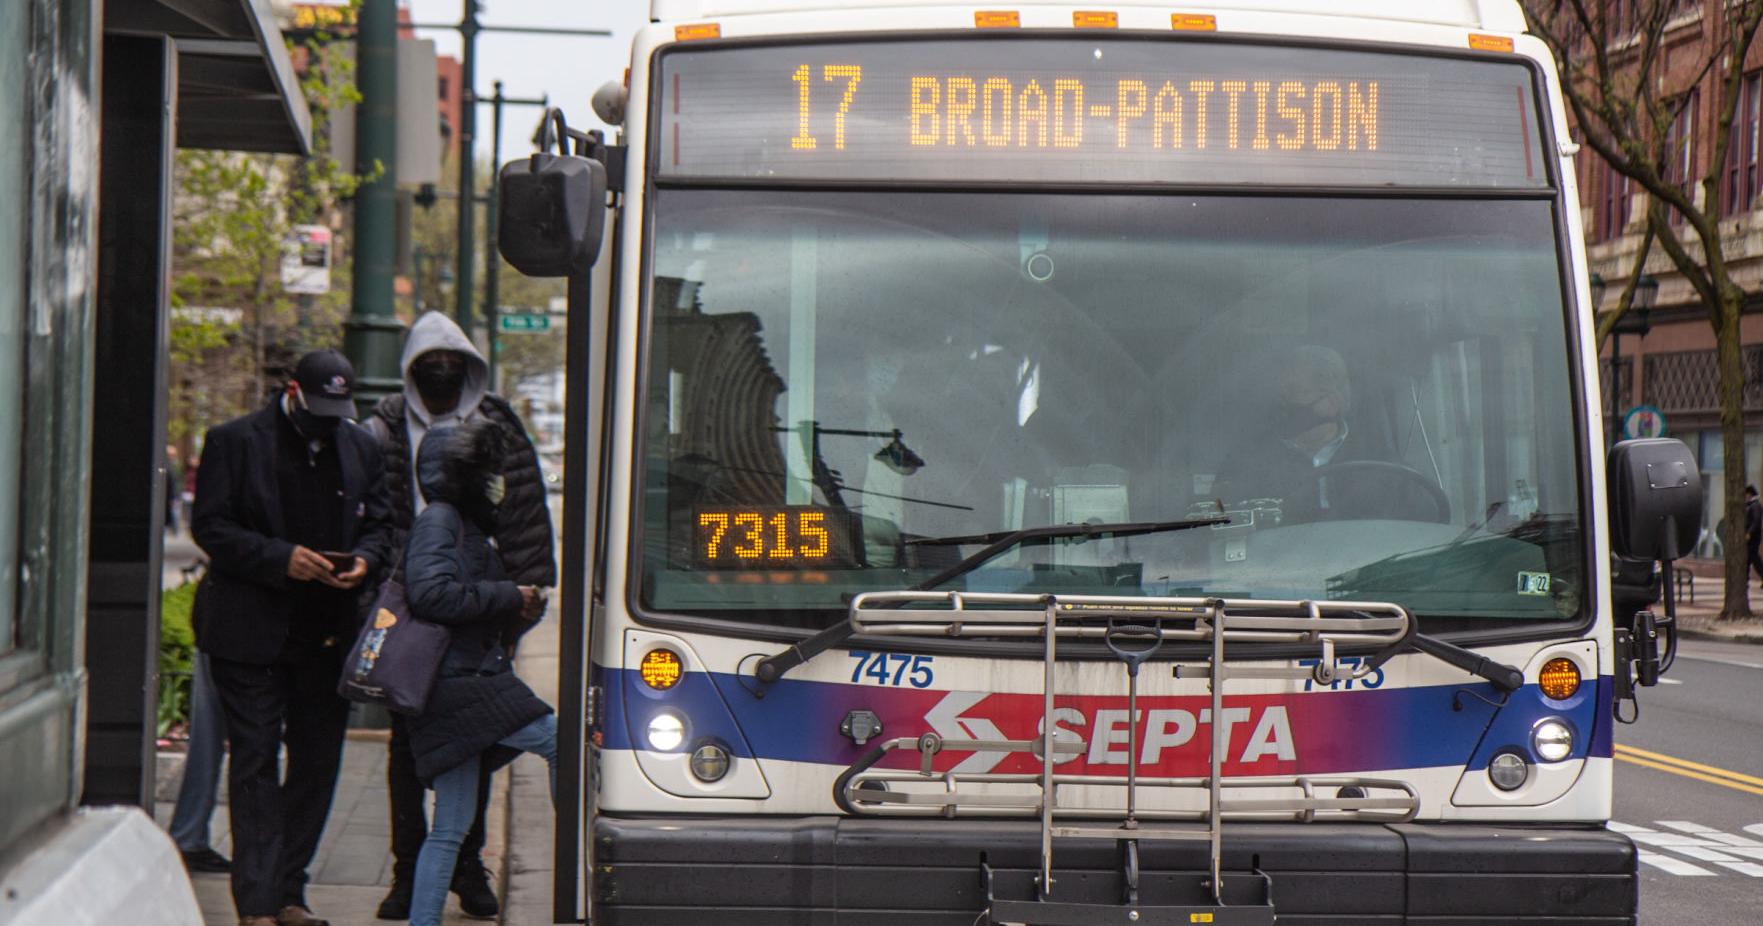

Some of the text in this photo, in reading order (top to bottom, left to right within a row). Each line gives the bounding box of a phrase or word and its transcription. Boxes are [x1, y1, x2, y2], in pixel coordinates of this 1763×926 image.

[792, 64, 1378, 151] 17 BROAD-PATTISON
[700, 512, 828, 559] 7315
[848, 649, 934, 689] 7475
[1032, 705, 1297, 765] SEPTA
